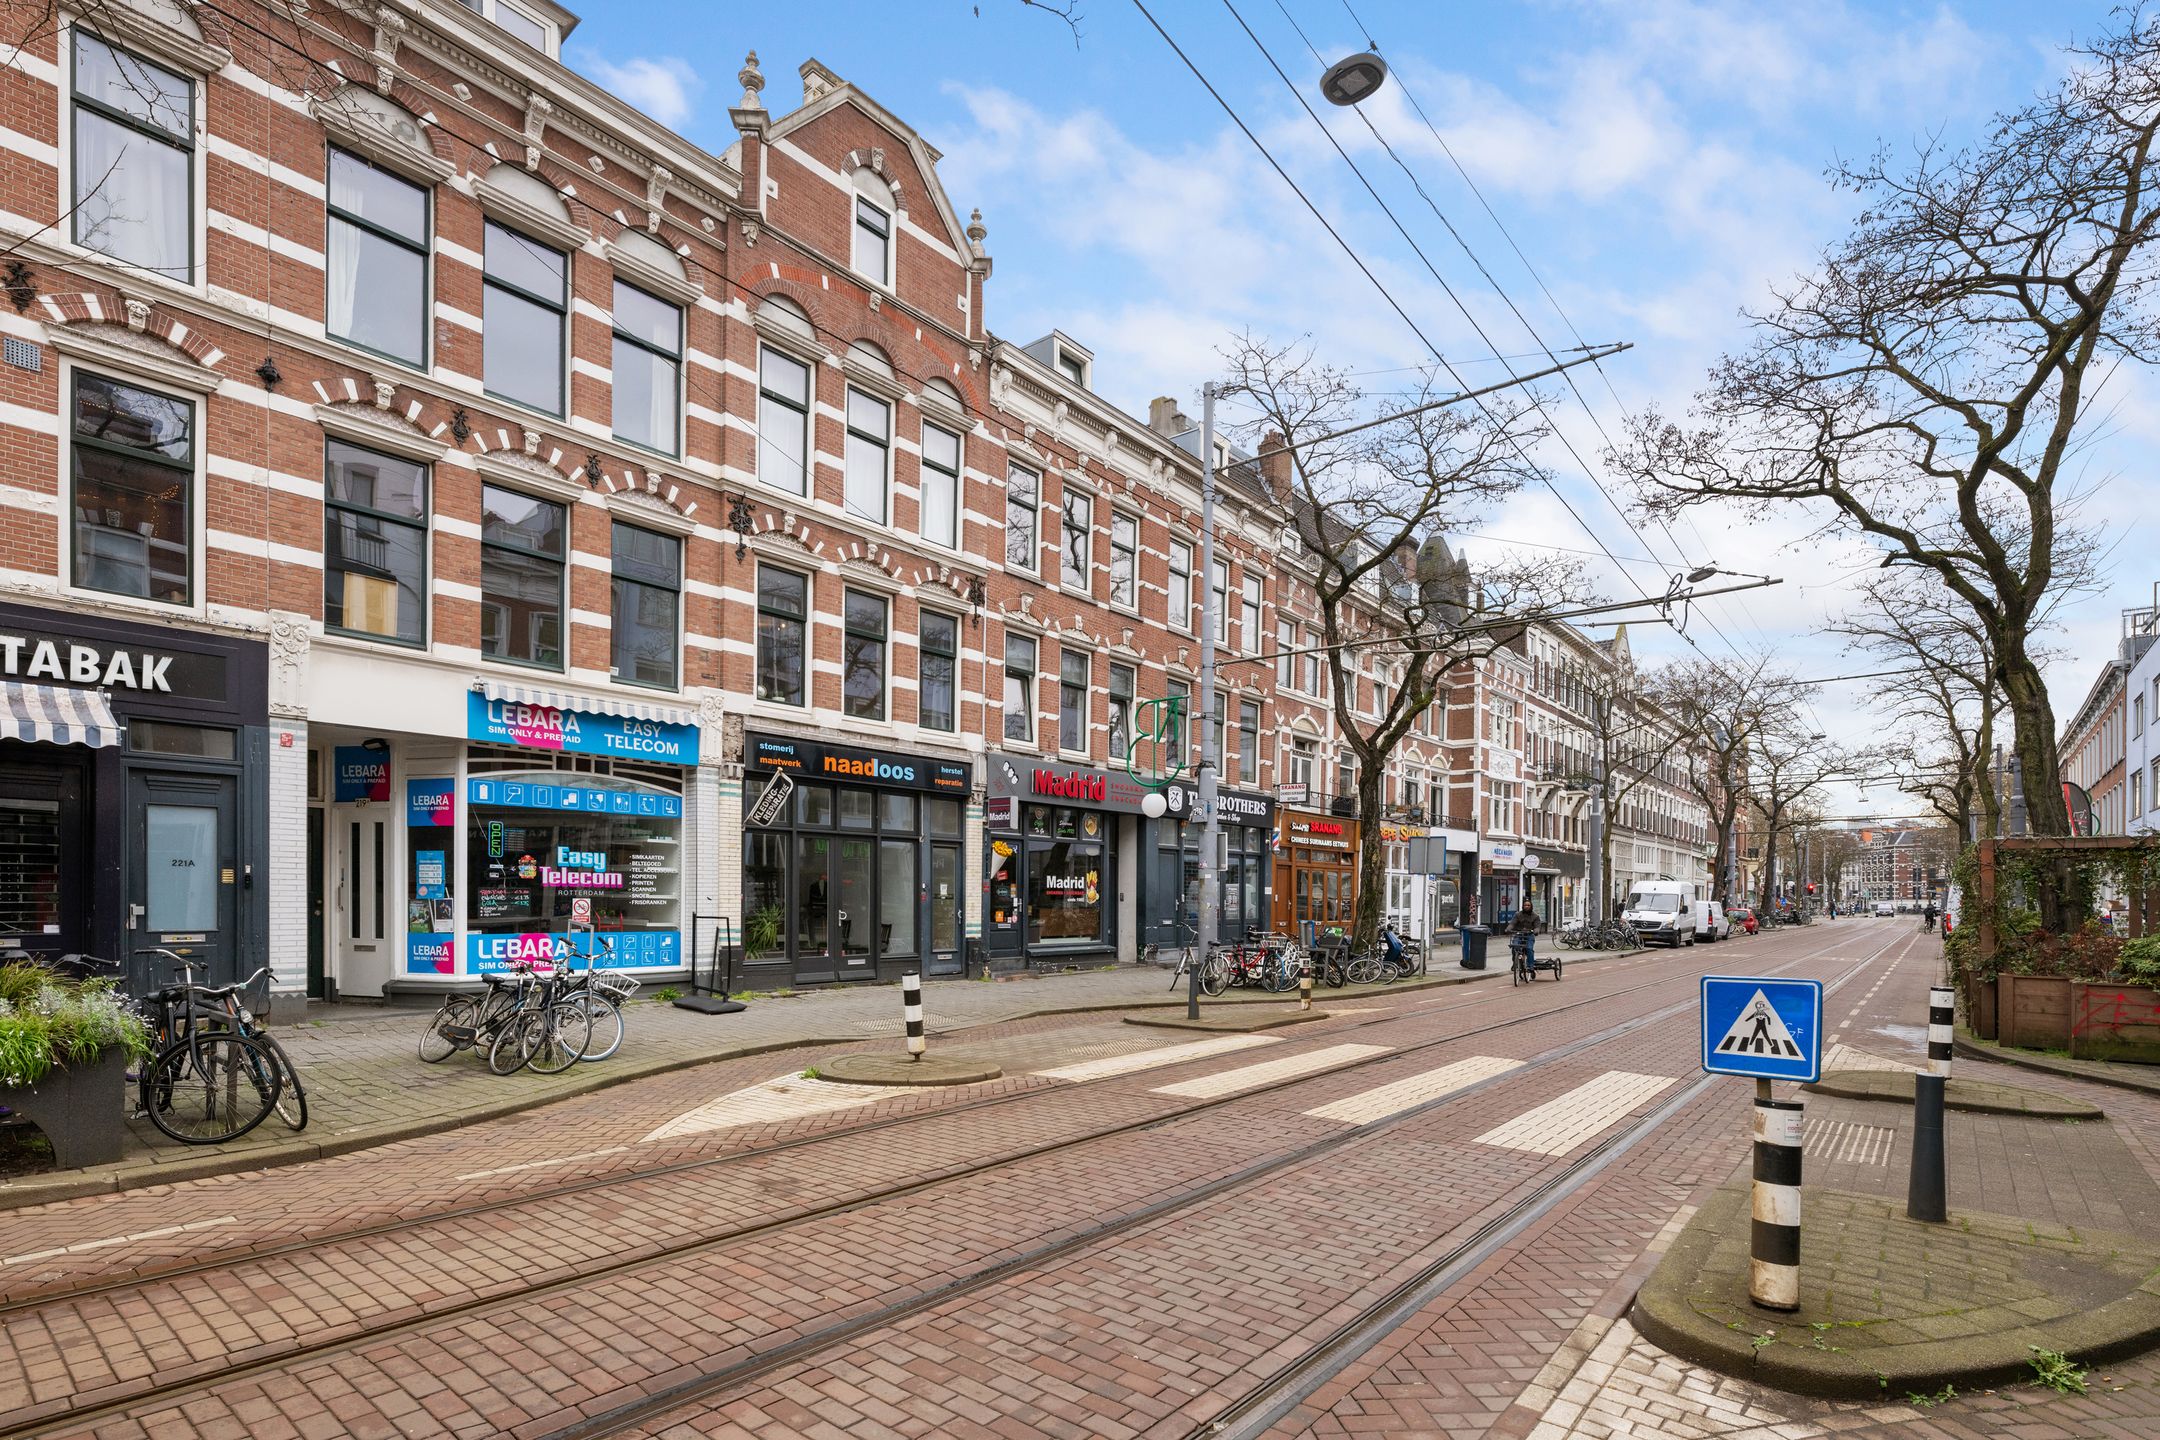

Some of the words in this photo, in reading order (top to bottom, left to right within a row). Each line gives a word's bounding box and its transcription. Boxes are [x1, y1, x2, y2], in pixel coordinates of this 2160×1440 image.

[0, 635, 173, 692] TABAK
[487, 702, 580, 734] LEBARA
[488, 725, 506, 735] SIM
[508, 728, 533, 739] ONLY
[534, 730, 542, 739] &
[544, 732, 581, 744] PREPAID
[623, 720, 662, 738] EASY
[604, 733, 679, 756] TELECOM
[760, 742, 794, 755] stomerij
[342, 764, 386, 777] LEBARA
[760, 756, 801, 767] maatwerk
[824, 755, 915, 781] naadloos
[940, 765, 963, 776] herstel
[934, 777, 964, 788] reparatie
[1032, 768, 1106, 801] Madrid
[412, 795, 449, 806] LEBARA
[763, 783, 789, 821] REPARATIE
[989, 812, 1011, 821] Madrid
[491, 823, 501, 855] OPEN
[171, 859, 195, 867] 221A
[557, 846, 606, 873] Easy
[539, 866, 623, 888] Telecom
[1046, 875, 1085, 889] Madrid
[413, 945, 449, 956] LEBARA
[478, 938, 568, 959] LEBARA
[478, 961, 496, 970] SIM
